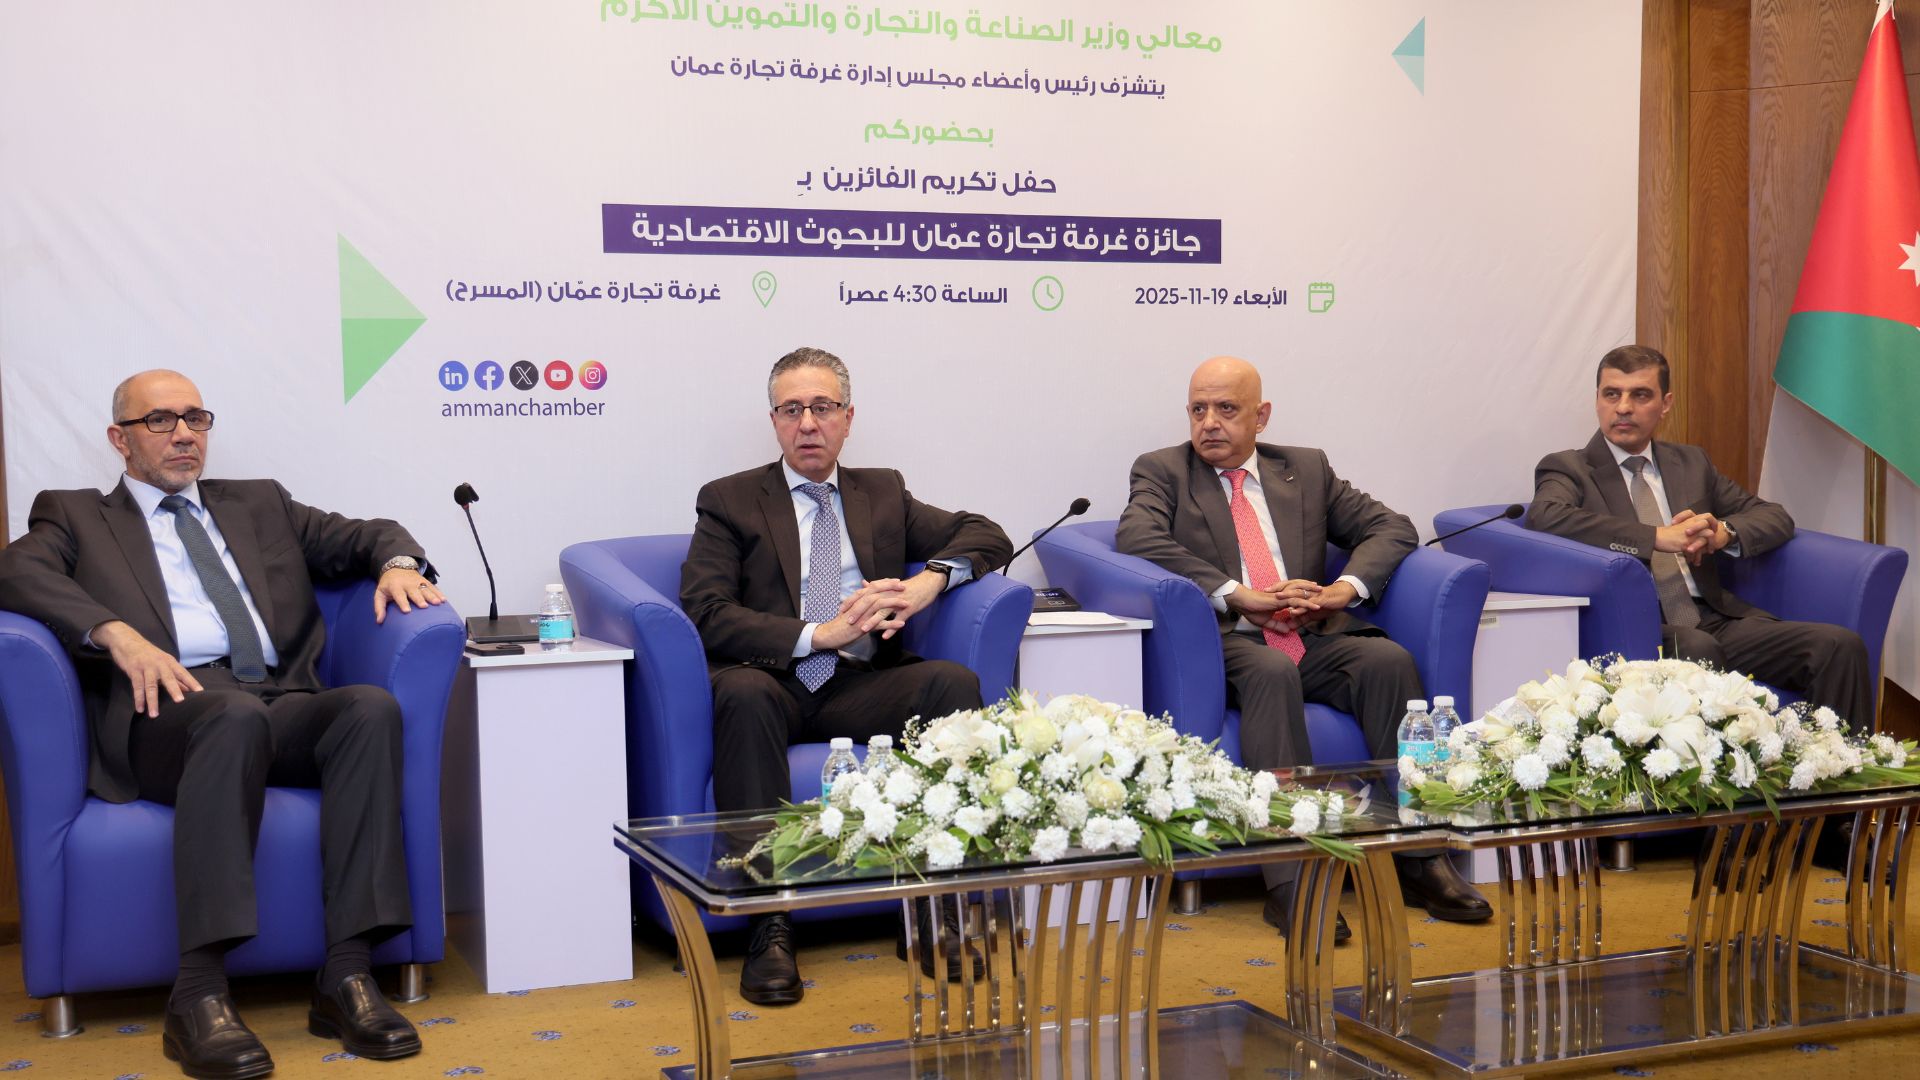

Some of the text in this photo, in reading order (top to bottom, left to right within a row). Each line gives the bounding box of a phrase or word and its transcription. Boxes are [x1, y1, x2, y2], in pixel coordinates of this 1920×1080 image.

[706, 0, 837, 34] والتموين
[844, 5, 958, 40] والتجارة
[965, 10, 1073, 42] الصناعة
[1082, 22, 1129, 50] وزير
[1136, 25, 1222, 59] معالي
[671, 56, 725, 77] عمان
[730, 58, 785, 81] تجارة
[790, 59, 842, 83] غرفة
[847, 64, 892, 88] إدارة
[897, 68, 966, 89] مجلس
[972, 68, 1040, 94] وأعضاء
[1045, 75, 1096, 96] رئيس
[864, 119, 993, 147] بحضوركم
[823, 165, 916, 192] الفائزين
[922, 170, 997, 195] تكريم
[1002, 170, 1056, 196] حفل
[632, 213, 788, 246] الاقتصادية
[796, 218, 905, 250] للبحوث
[988, 225, 1056, 253] تجارة
[1063, 224, 1127, 255] غرفة
[1135, 228, 1200, 256] جائزة
[446, 279, 542, 303] (المسرح)
[607, 280, 663, 303] تجارة
[668, 280, 721, 304] غرفة
[893, 285, 937, 303] 4:30
[942, 284, 1007, 304] الساعة
[442, 397, 605, 417] ammanchamber
